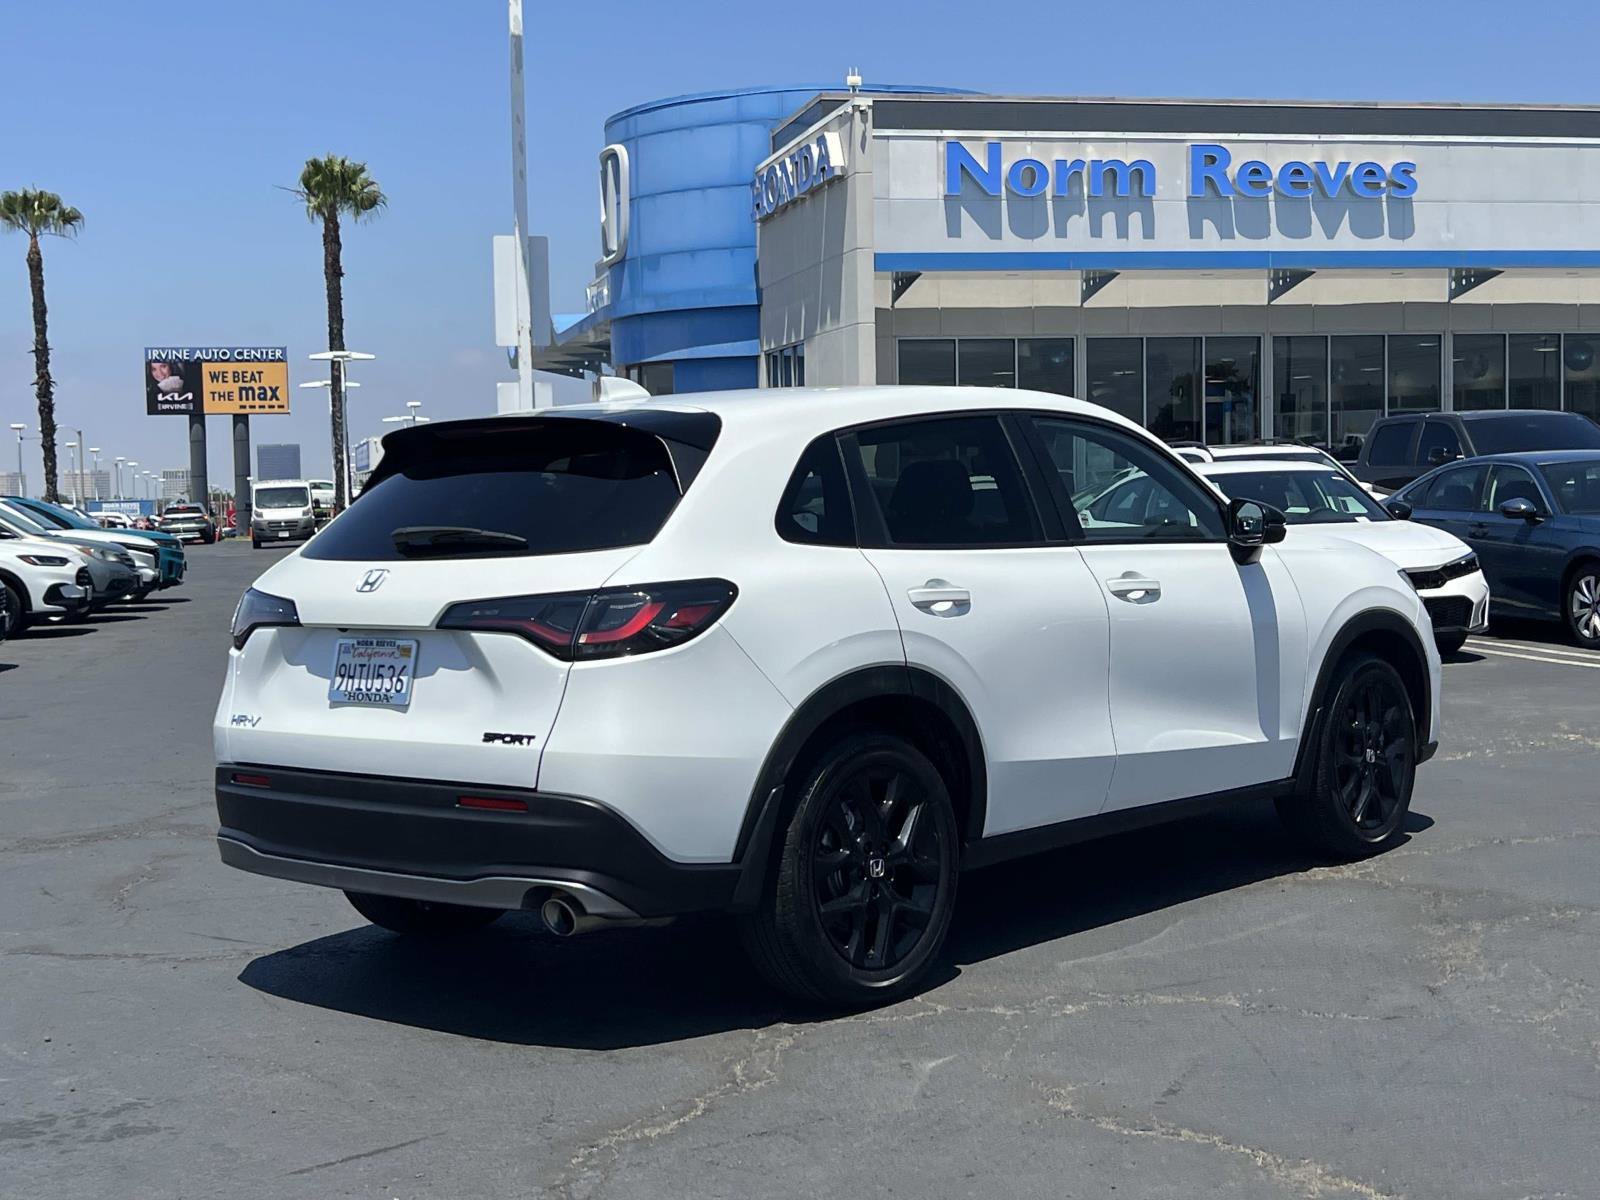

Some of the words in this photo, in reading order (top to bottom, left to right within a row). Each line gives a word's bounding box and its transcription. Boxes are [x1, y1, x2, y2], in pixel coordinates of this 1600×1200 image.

[945, 141, 1157, 198] Norm
[1188, 143, 1419, 198] Reeves
[751, 134, 835, 220] HONDA
[147, 348, 190, 360] IRVINE
[194, 348, 231, 360] AUTO
[234, 348, 283, 360] CENTER
[209, 370, 229, 384] WE
[232, 370, 264, 384] BEAT
[210, 391, 235, 402] THE
[238, 385, 280, 402] max
[336, 663, 407, 694] 9HIU536
[347, 692, 390, 703] HONDA
[231, 714, 262, 728] HR-V
[482, 732, 536, 746] SPORT
